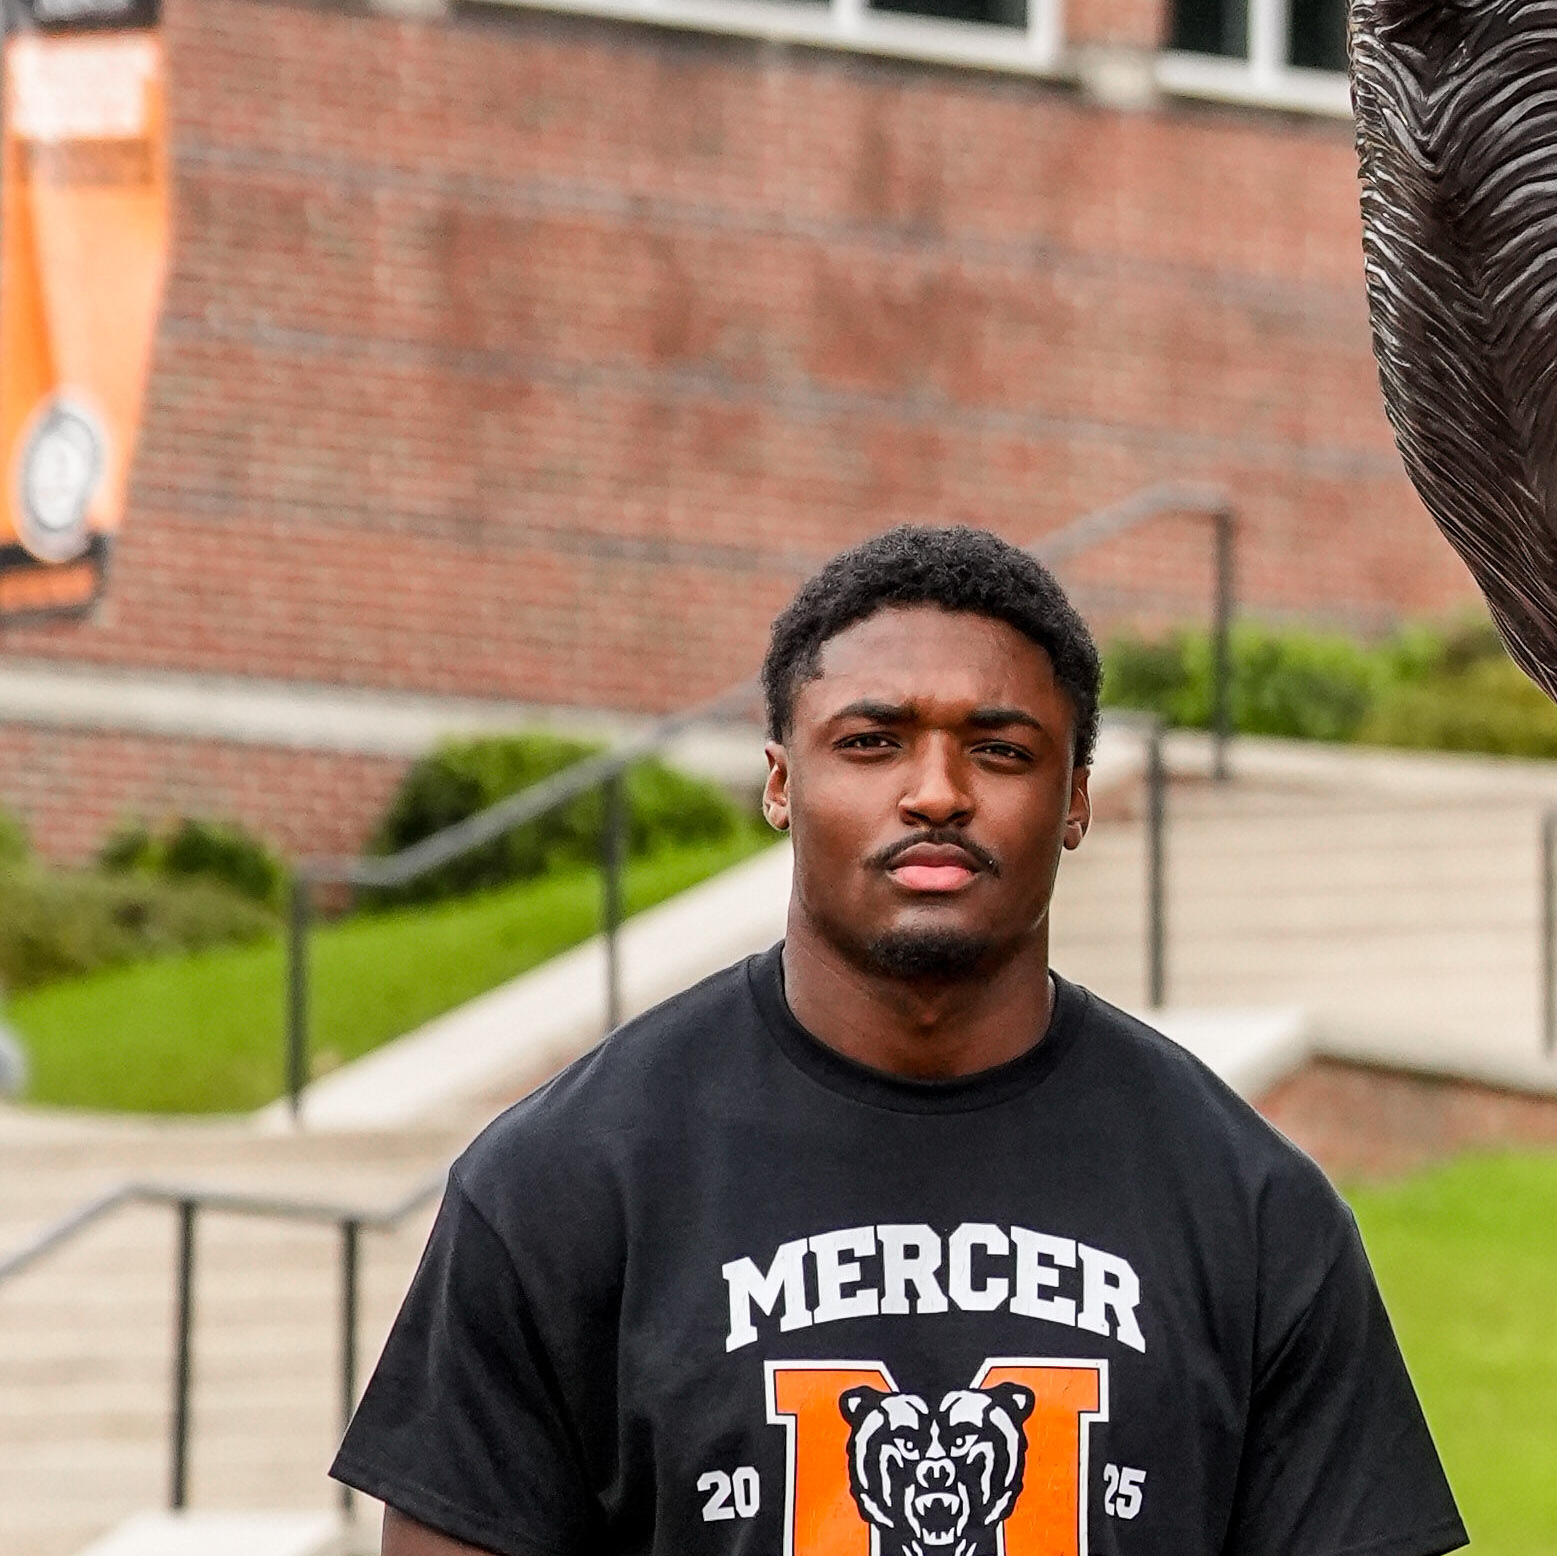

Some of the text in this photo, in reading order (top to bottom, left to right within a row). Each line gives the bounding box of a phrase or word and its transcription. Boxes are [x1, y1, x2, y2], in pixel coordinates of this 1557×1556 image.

[721, 1222, 1146, 1353] MERCER
[697, 1462, 1147, 1522] 20 25
